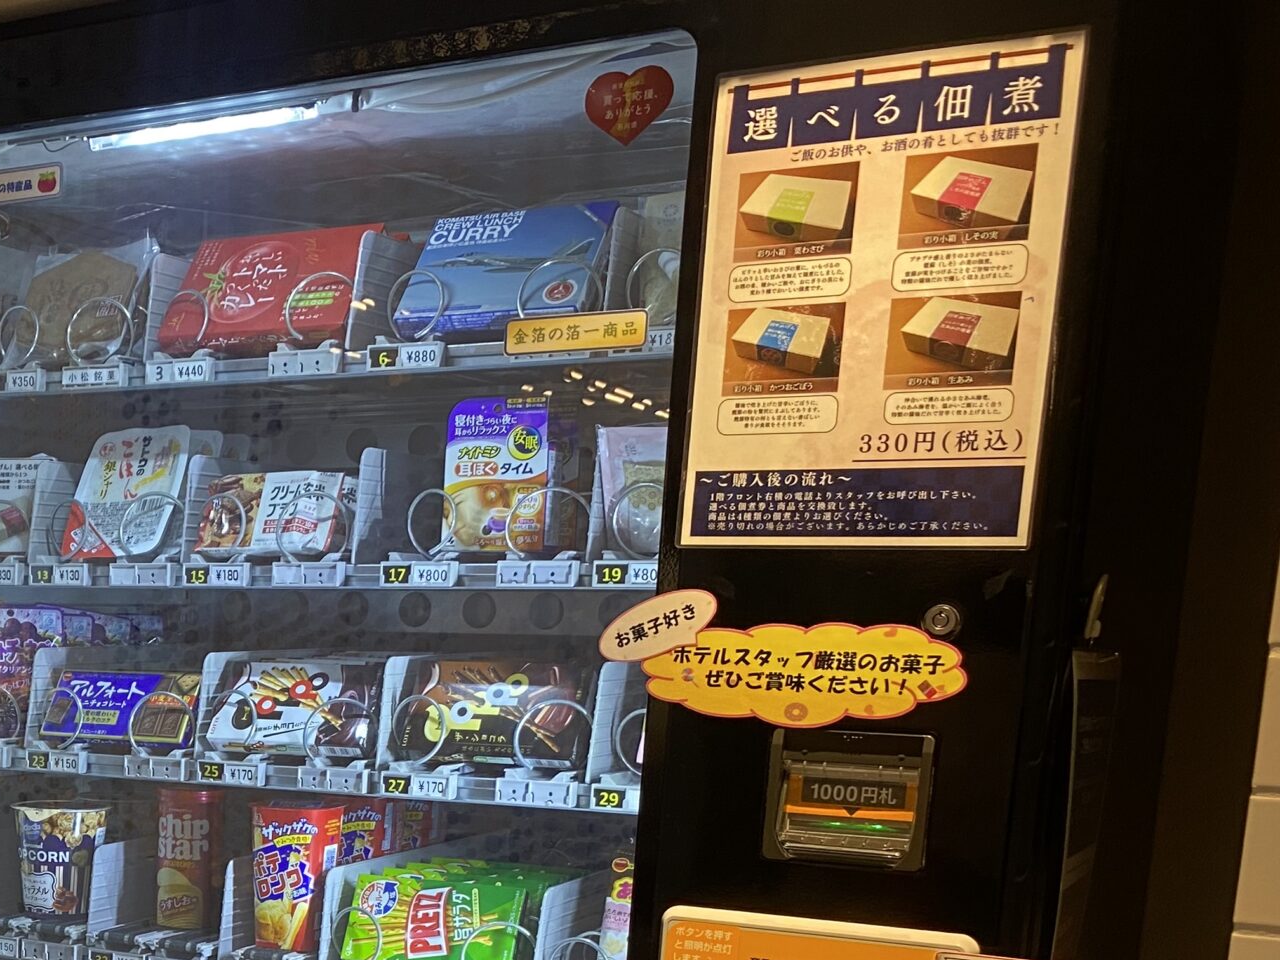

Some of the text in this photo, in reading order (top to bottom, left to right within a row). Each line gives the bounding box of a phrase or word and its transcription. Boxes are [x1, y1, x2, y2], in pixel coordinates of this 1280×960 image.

[605, 104, 651, 119] ありがとう
[743, 76, 1044, 142] 選べる佃煮
[435, 216, 523, 231] CREW LUNCH
[438, 215, 481, 224] KOMATSU
[430, 224, 519, 245] CURRY
[923, 230, 999, 244] 彩り小箱 しその実
[513, 320, 638, 345] 金箔の箔一商品
[406, 349, 436, 363] ¥880
[68, 371, 117, 383] 小松銘菓
[177, 364, 204, 379] ¥440
[11, 374, 35, 389] ¥350
[769, 382, 814, 392] かつおごぼう
[908, 374, 973, 386] 彩り小箱 生あみ
[455, 414, 517, 427] 寝付きづらい夜に
[455, 425, 507, 436] 耳からリラックス
[514, 429, 538, 452] 安眠
[136, 435, 153, 476] サトウの
[458, 446, 501, 460] ナイトミン
[99, 460, 116, 498] 銀シャリ
[60, 569, 80, 581] ¥130
[190, 569, 239, 582] 15 ¥180
[389, 568, 448, 582] 17 ¥800
[602, 567, 621, 582] 19
[616, 604, 697, 648] お菓子好き
[672, 647, 945, 675] ホテルスタッフ厳選のお菓子
[70, 679, 146, 700] アルフォート
[705, 670, 907, 696] ぜひご賞味ください！
[32, 755, 77, 769] 23 ¥150
[204, 765, 253, 780] 25 ¥170
[388, 780, 444, 794] 27 ¥170
[810, 783, 896, 805] 1000円札
[599, 792, 619, 805] 29
[158, 813, 210, 840] chip
[158, 837, 209, 861] star
[254, 851, 280, 877] ポテ
[410, 892, 443, 953] PRETZ
[453, 890, 473, 941] 旨サラダ
[675, 927, 733, 941] ボタンを押す
[674, 939, 732, 955] と照明が点灯
